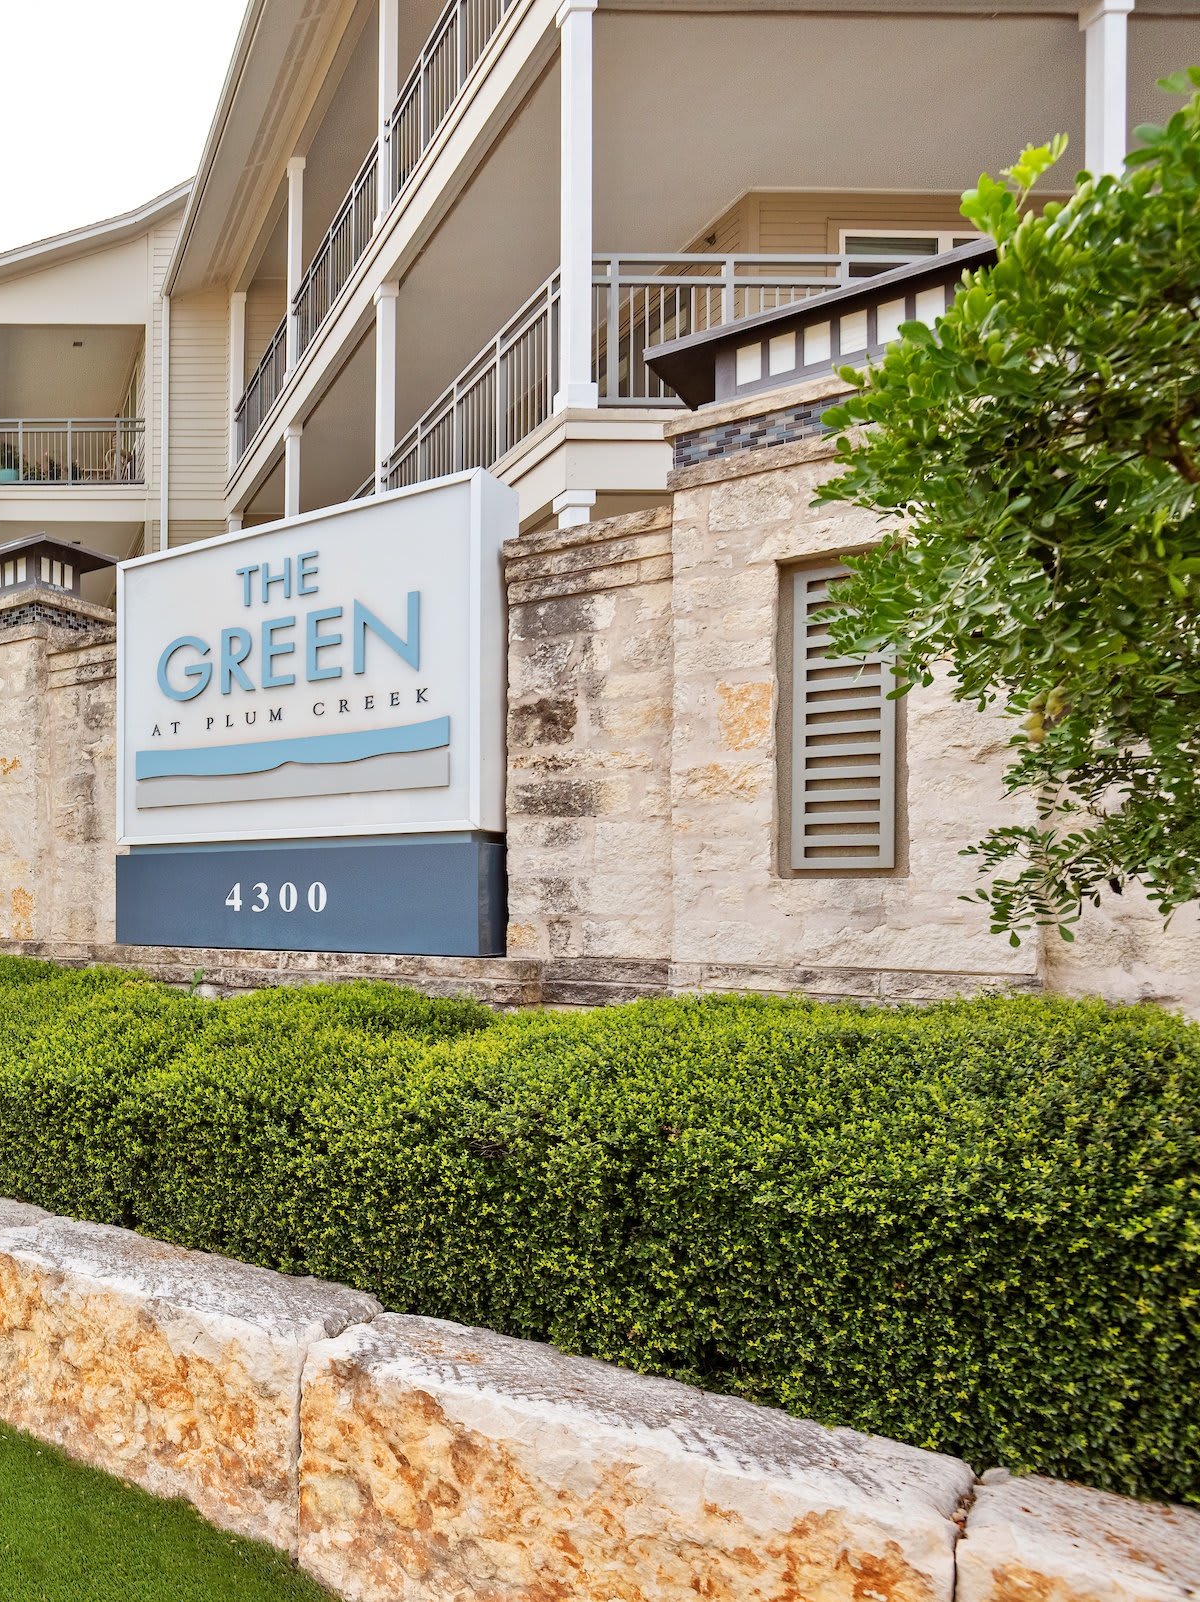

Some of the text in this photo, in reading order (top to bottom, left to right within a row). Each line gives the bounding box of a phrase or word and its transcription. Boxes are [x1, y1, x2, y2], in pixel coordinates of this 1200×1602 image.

[236, 550, 319, 607] THE
[156, 590, 420, 701] GREEN
[152, 688, 427, 736] AT PLUM CREEK
[225, 881, 327, 912] 4300
